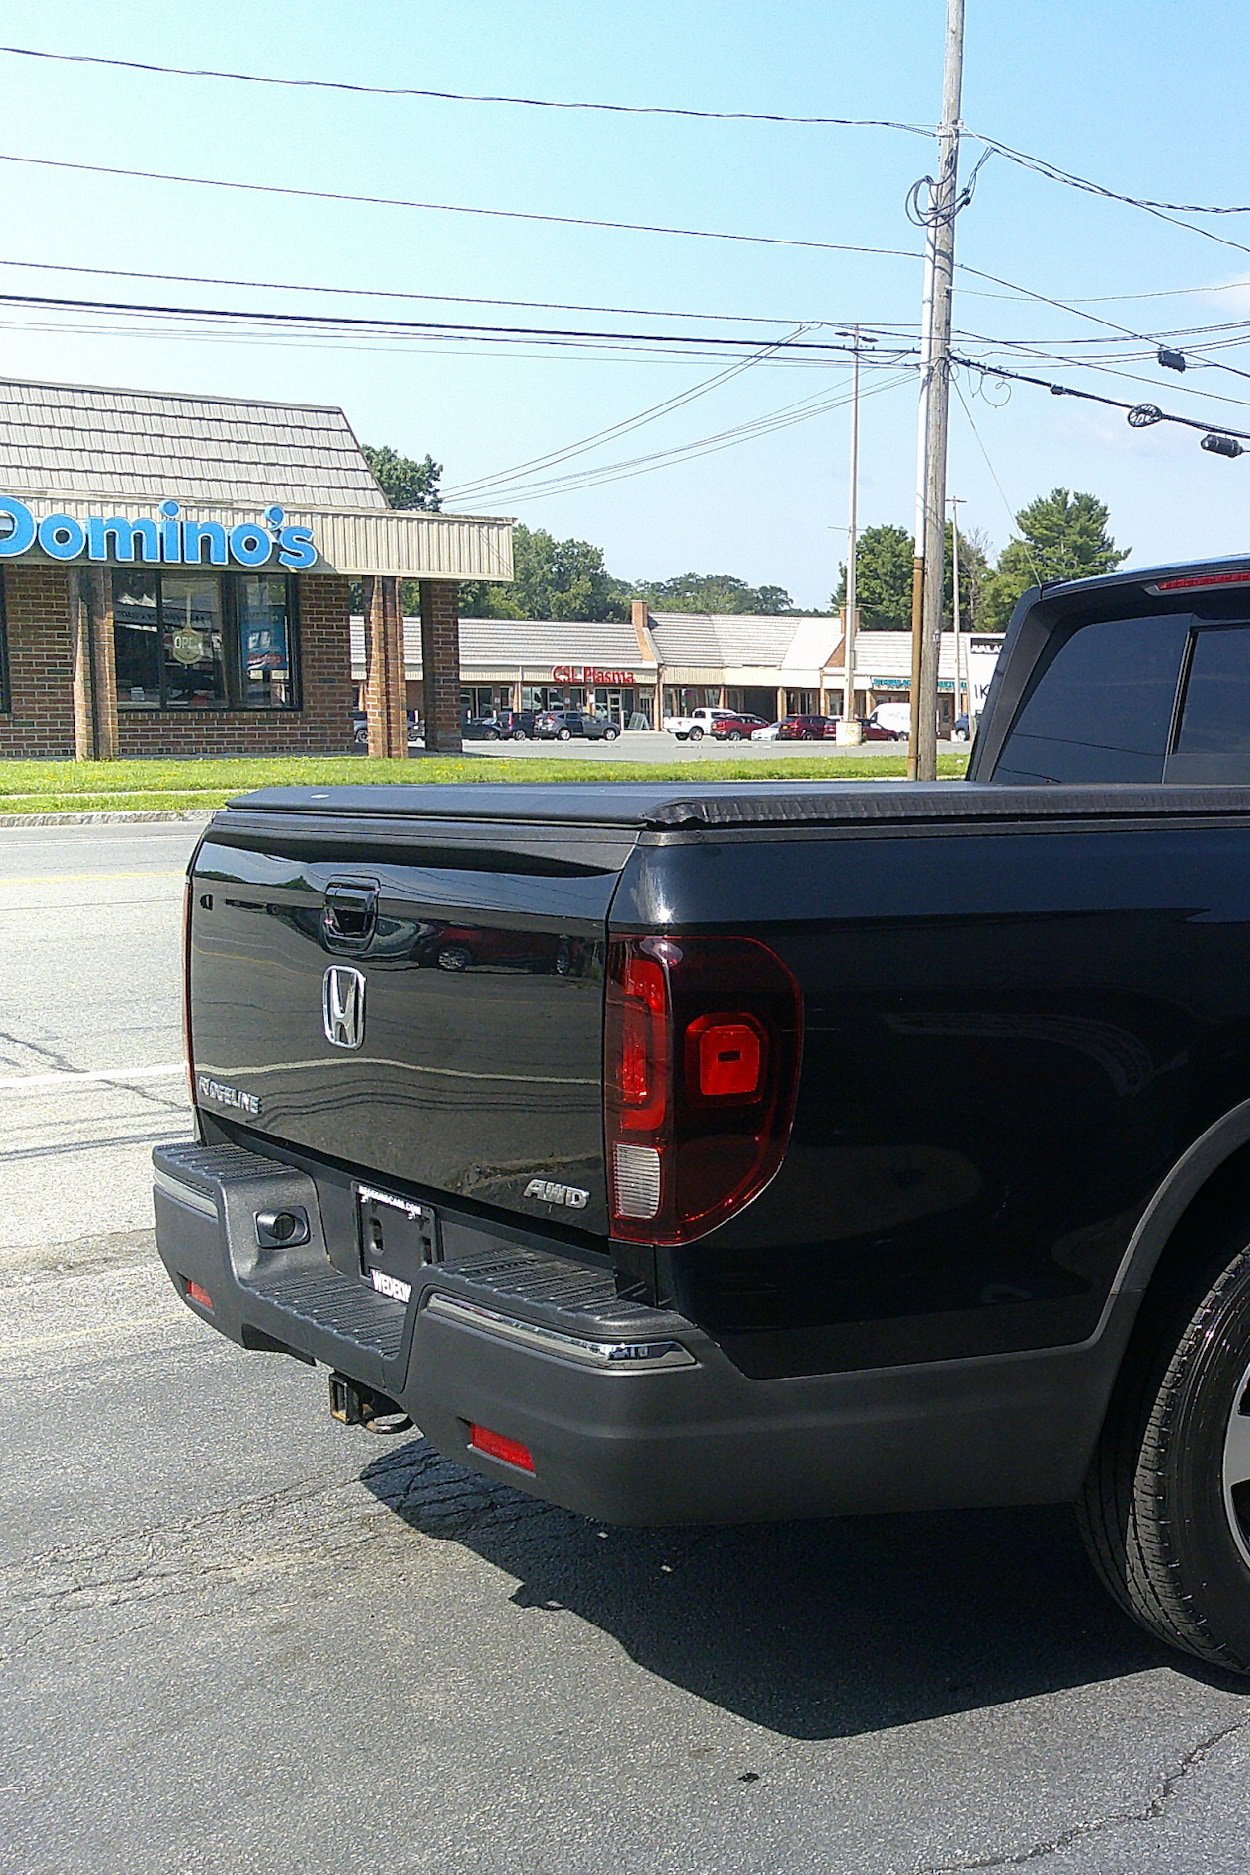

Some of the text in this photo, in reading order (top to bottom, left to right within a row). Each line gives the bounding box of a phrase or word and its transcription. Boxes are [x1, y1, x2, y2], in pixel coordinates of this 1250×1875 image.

[0, 495, 319, 568] Domino's
[552, 665, 636, 684] CSL Plasma
[523, 1178, 590, 1209] AWD
